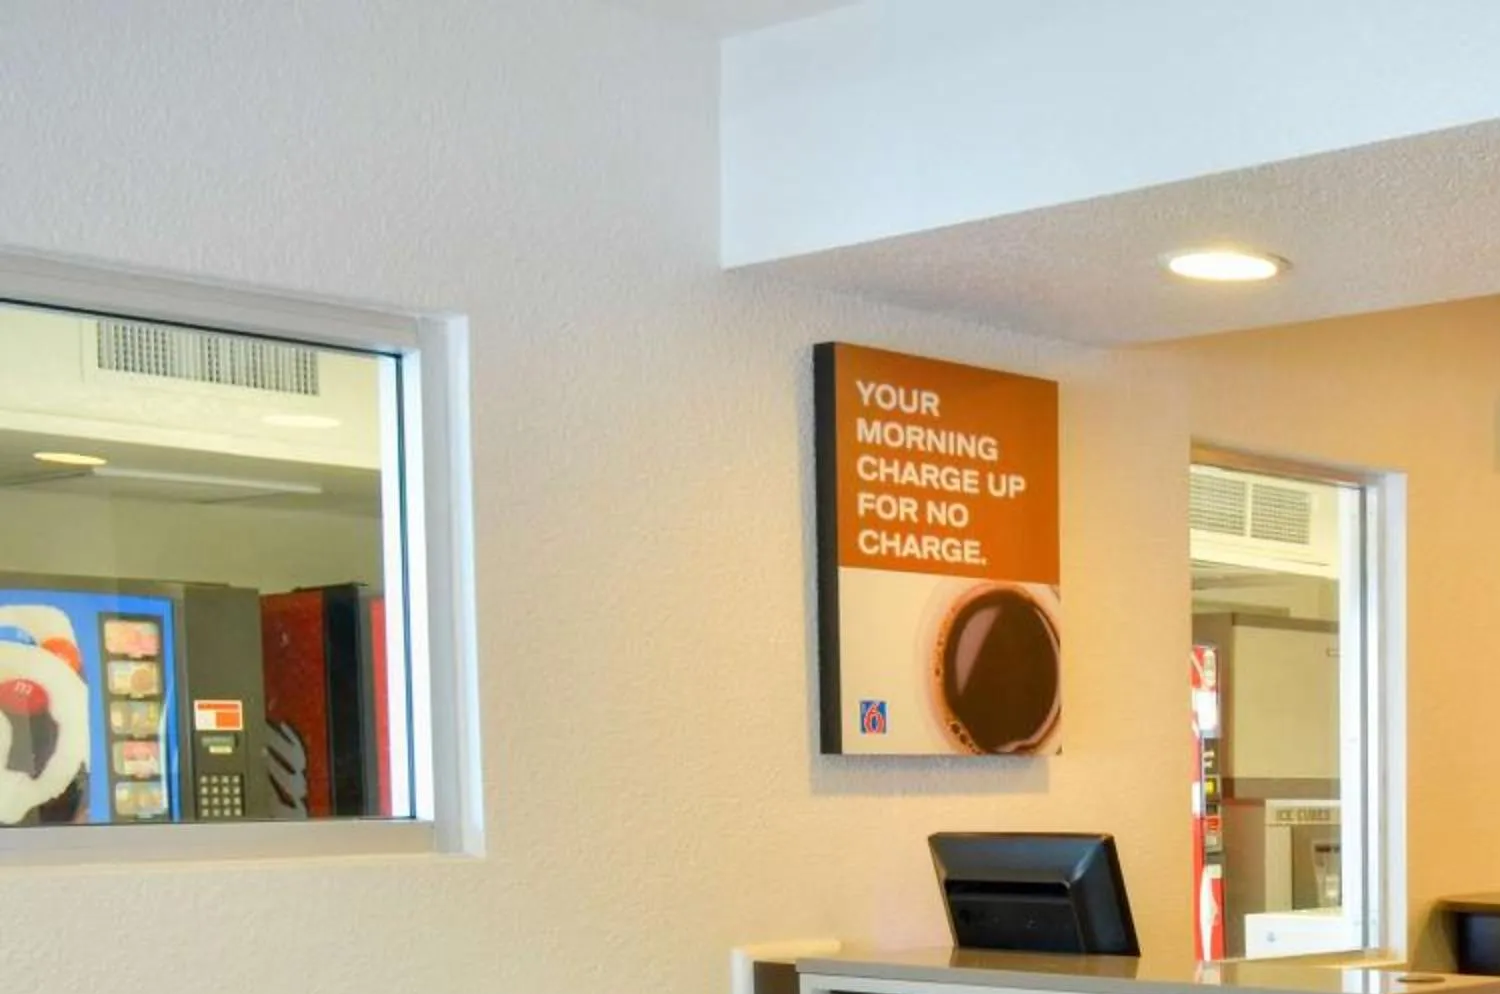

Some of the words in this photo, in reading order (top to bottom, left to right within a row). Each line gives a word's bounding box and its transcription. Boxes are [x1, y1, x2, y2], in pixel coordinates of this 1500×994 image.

[856, 380, 940, 417] YOUR
[856, 418, 999, 462] MORNING
[856, 456, 980, 495] CHARGE
[987, 472, 1026, 500] UP
[857, 492, 918, 524] FOR
[926, 501, 969, 528] NO
[858, 529, 988, 567] CHARGE.
[864, 702, 885, 733] 6
